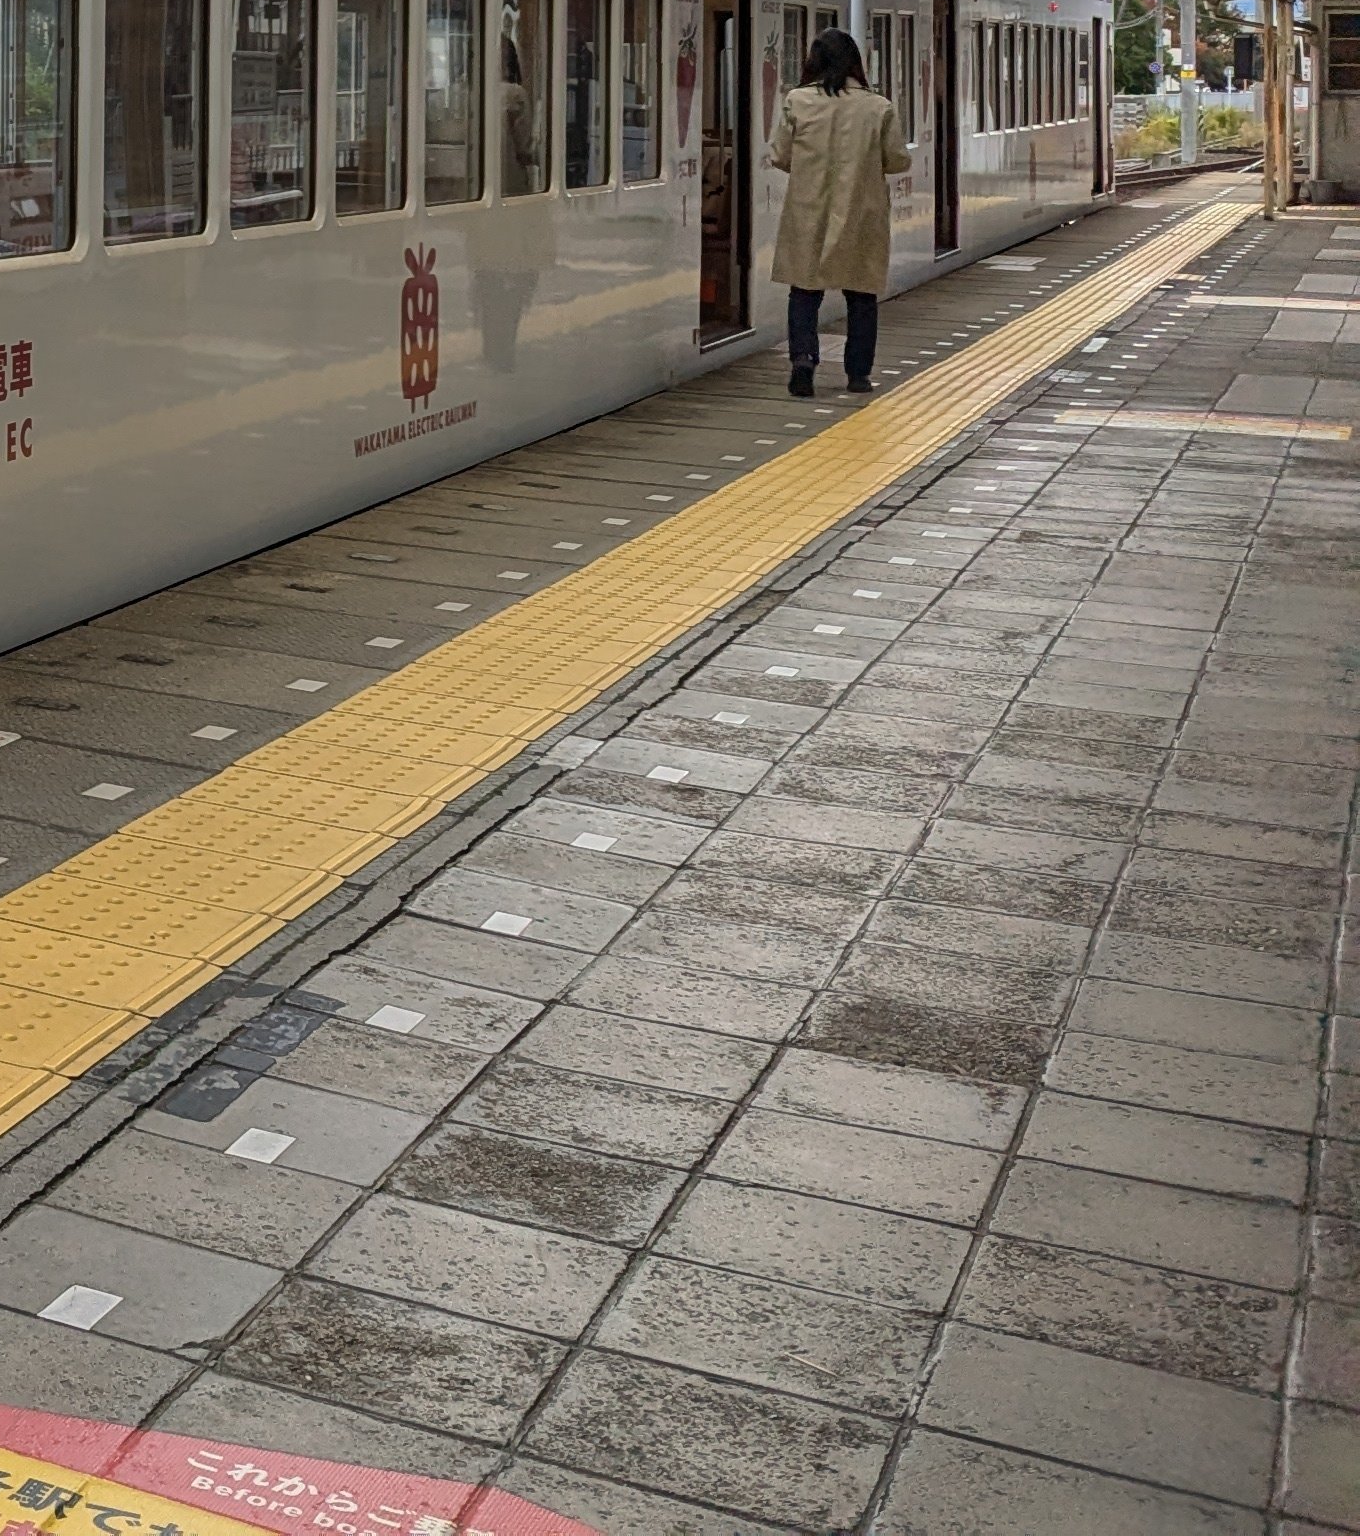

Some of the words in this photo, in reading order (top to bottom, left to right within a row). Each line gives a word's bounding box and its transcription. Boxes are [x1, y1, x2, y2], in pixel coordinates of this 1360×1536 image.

[7, 417, 33, 462] EC
[354, 424, 406, 458] WAKAYAMA
[408, 410, 444, 440] ELECTRIC
[445, 400, 477, 427] RAILWAY
[187, 1449, 496, 1536] これからご乗
[190, 1476, 303, 1523] Before
